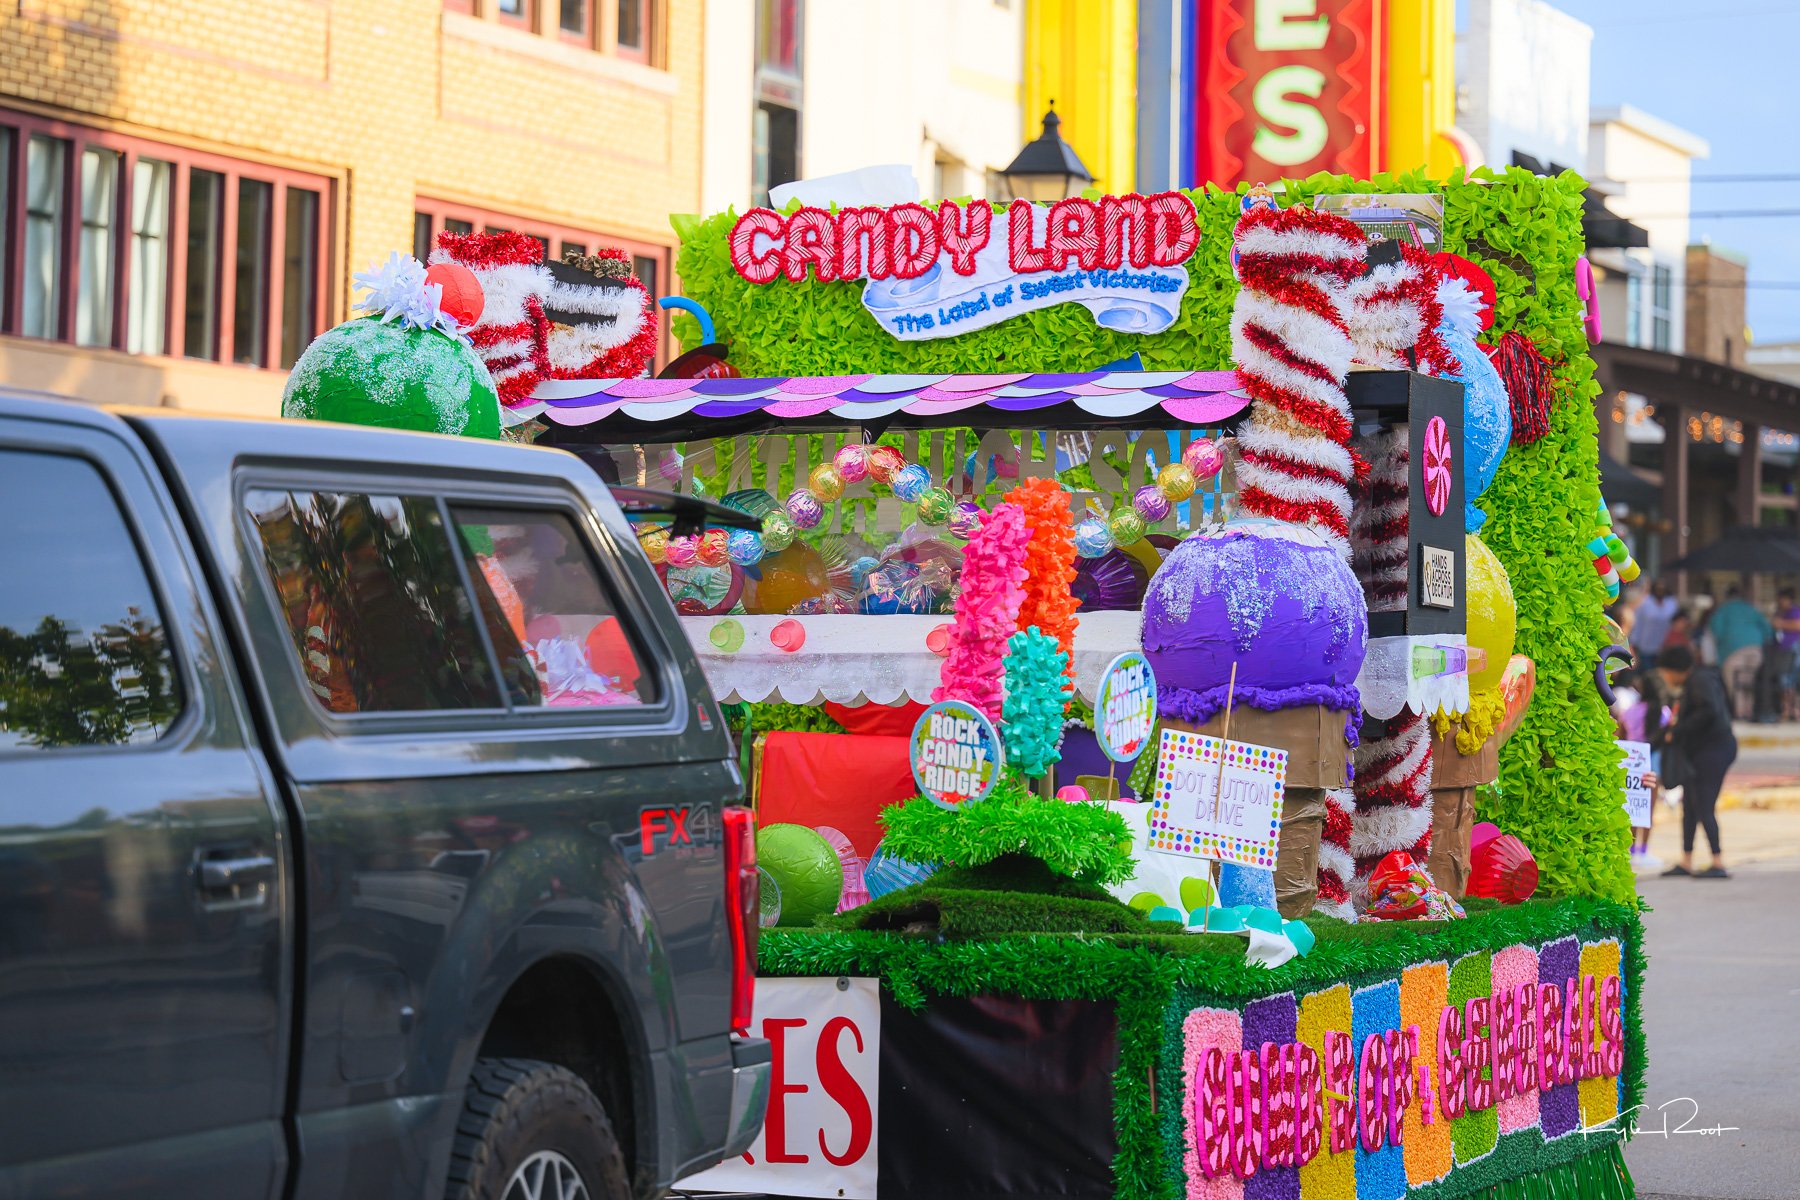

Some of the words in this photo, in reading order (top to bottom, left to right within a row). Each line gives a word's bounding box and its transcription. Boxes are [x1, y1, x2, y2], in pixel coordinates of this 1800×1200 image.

[727, 197, 992, 285] CANDY
[1007, 190, 1202, 274] LAND
[892, 312, 934, 333] The
[939, 292, 990, 325] Land
[992, 284, 1014, 306] of
[1019, 271, 1086, 300] Sweet
[1086, 269, 1183, 294] Victories
[1432, 553, 1448, 570] HANDS
[1432, 568, 1452, 585] ACROSS
[1432, 582, 1453, 600] DECATUR
[1110, 663, 1144, 697] ROCK
[1106, 686, 1149, 724] CANDY
[930, 713, 980, 745] ROCK
[1110, 713, 1148, 750] RIDGE
[922, 738, 987, 772] CANDY
[925, 765, 981, 797] RIDGE
[1174, 769, 1206, 794] DOT
[1211, 775, 1270, 806] BUTTON
[641, 802, 714, 856] FX4
[1195, 798, 1244, 827] DRIVE
[1437, 974, 1625, 1120] GENERALS
[738, 1016, 873, 1167] ES
